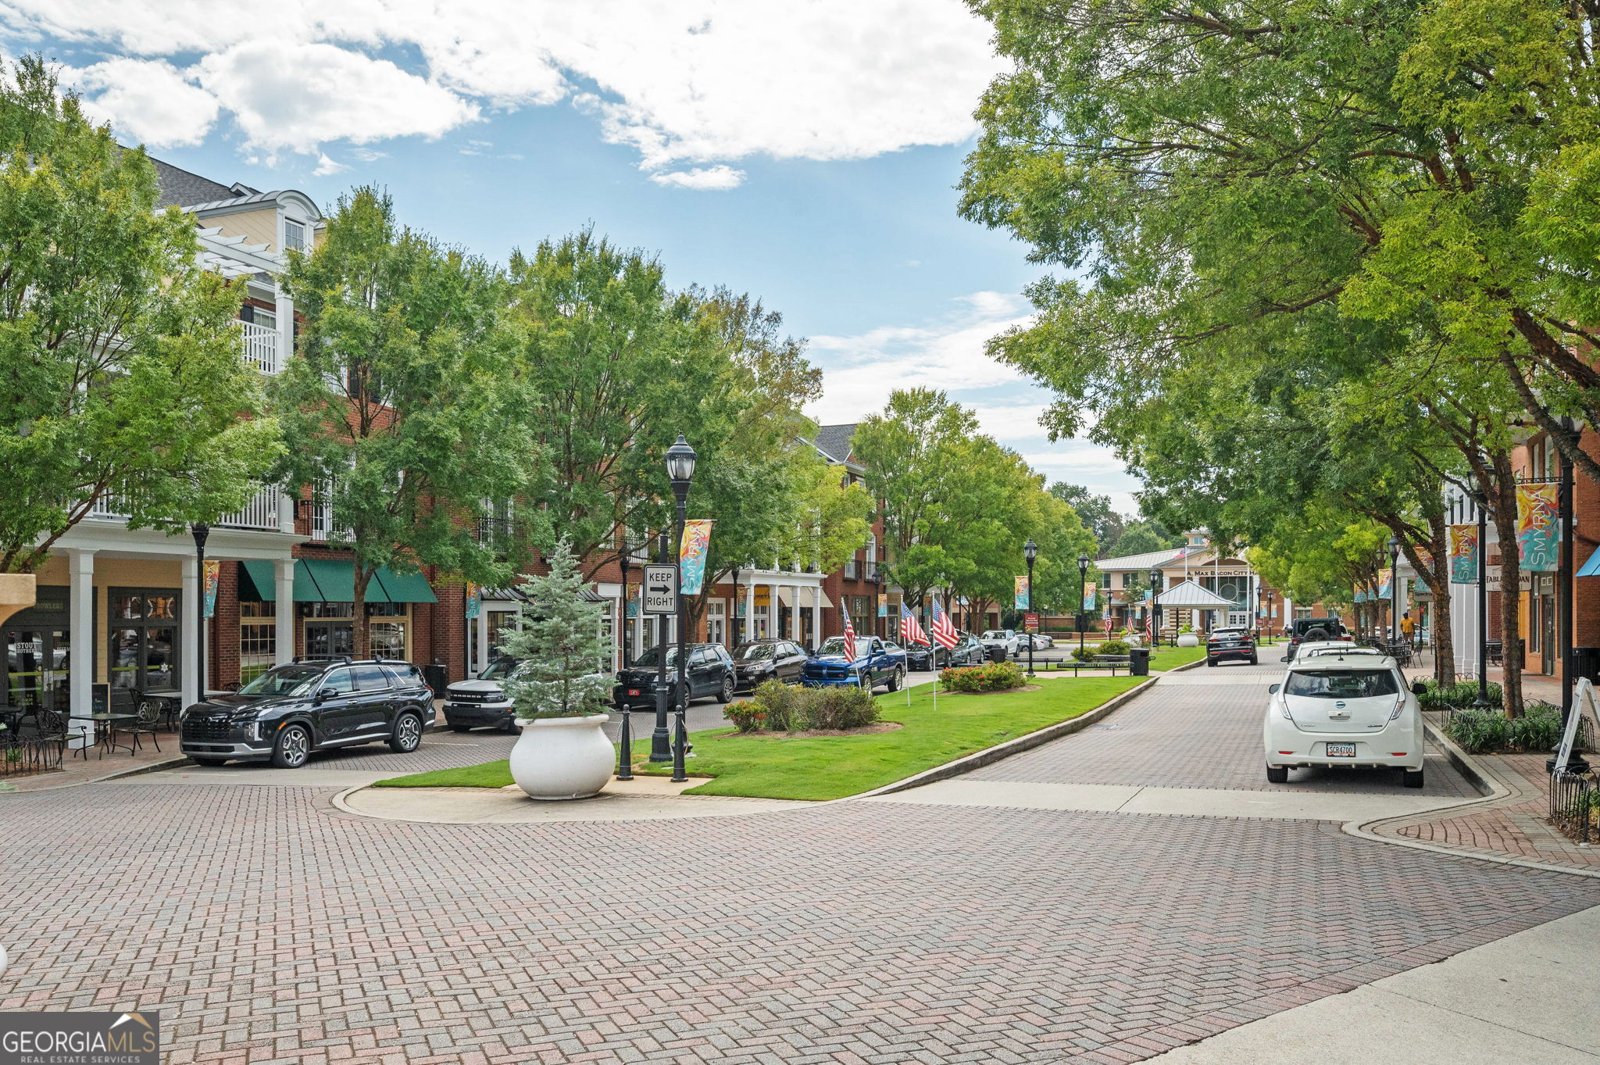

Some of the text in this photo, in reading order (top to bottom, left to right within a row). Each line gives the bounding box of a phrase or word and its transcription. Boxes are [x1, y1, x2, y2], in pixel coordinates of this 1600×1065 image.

[1530, 489, 1546, 565] SMYRNA
[649, 573, 672, 582] KEEP
[687, 527, 702, 589] SMYRNA
[1458, 528, 1470, 580] SMYRNA
[647, 597, 674, 606] RIGHT
